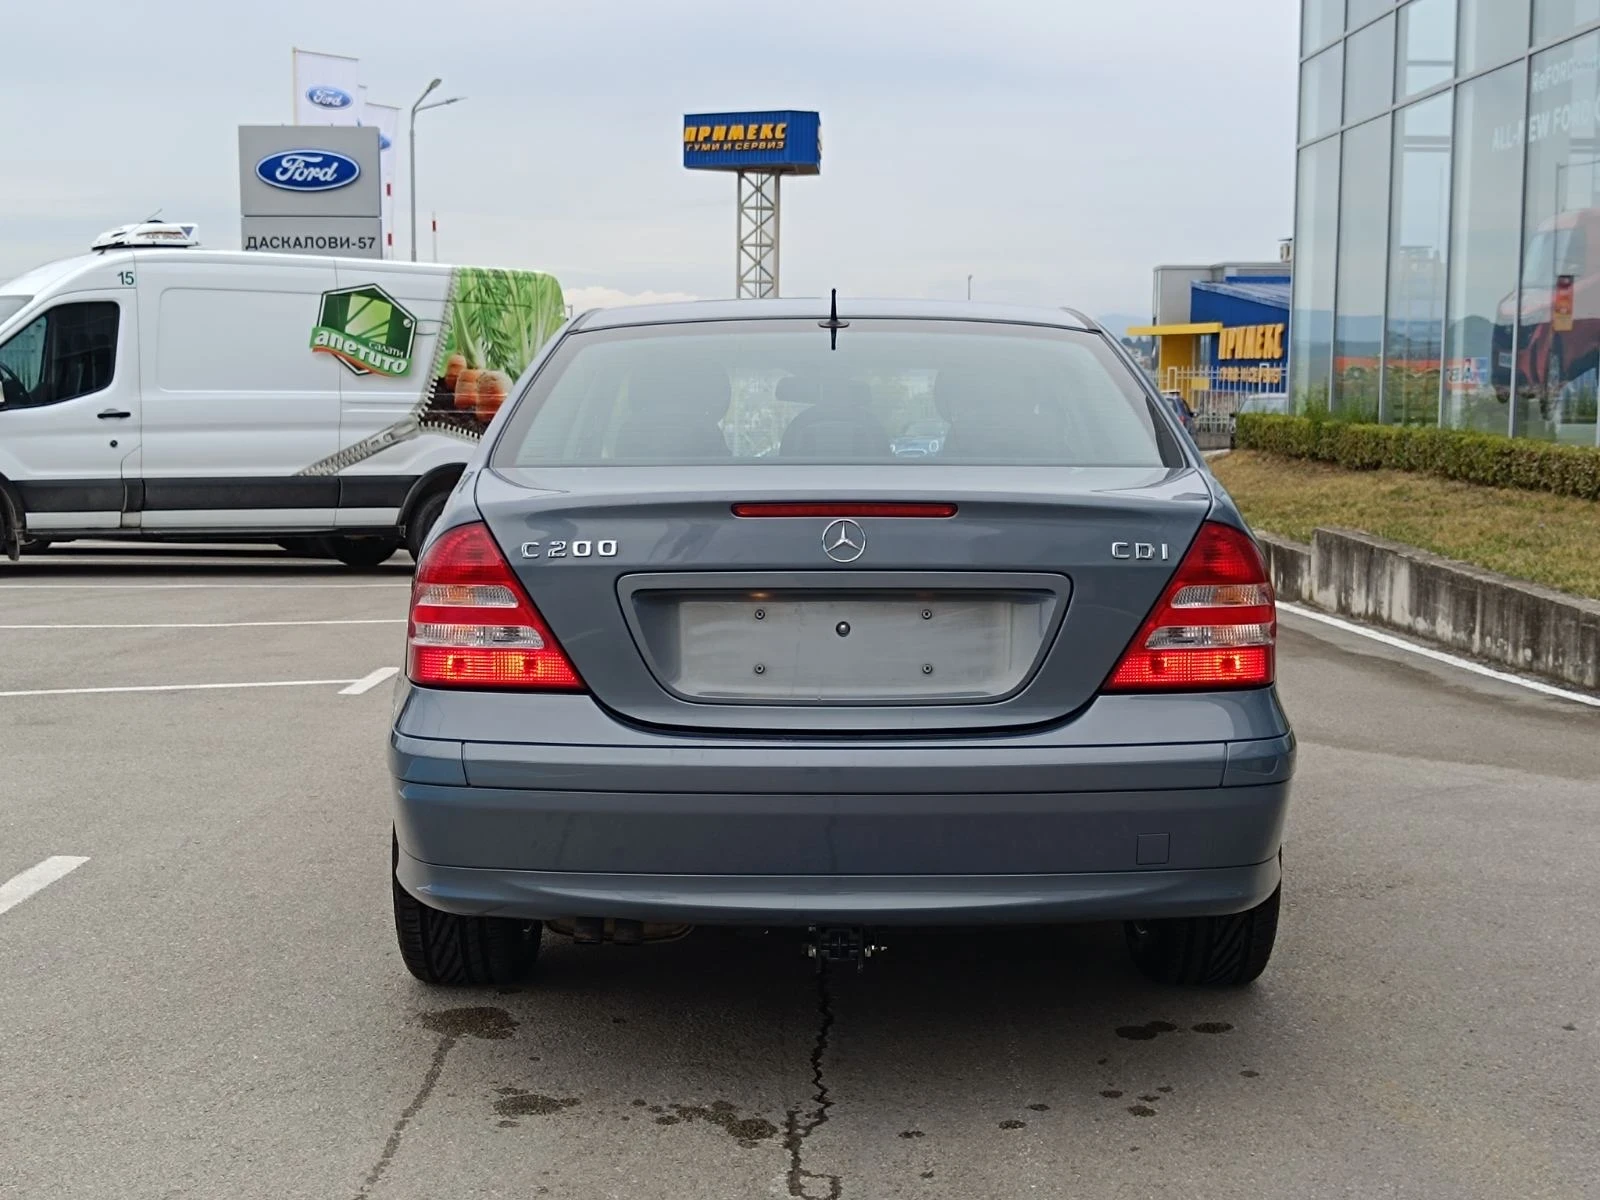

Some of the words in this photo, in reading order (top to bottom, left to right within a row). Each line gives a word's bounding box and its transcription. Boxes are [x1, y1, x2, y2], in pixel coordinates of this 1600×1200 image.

[313, 89, 342, 106] Ford
[684, 123, 787, 142] ПРИМЕКС
[686, 142, 720, 151] ГУМИ
[723, 143, 732, 151] И
[735, 141, 784, 151] СЕРВИЗ
[275, 154, 339, 182] Ford
[245, 236, 376, 250] ДАСКАЛОВИ-57
[117, 271, 134, 285] 15
[1218, 324, 1284, 360] ПРИМЕКС
[521, 541, 540, 558] C
[547, 540, 618, 557] 200
[1111, 541, 1169, 560] CDI
